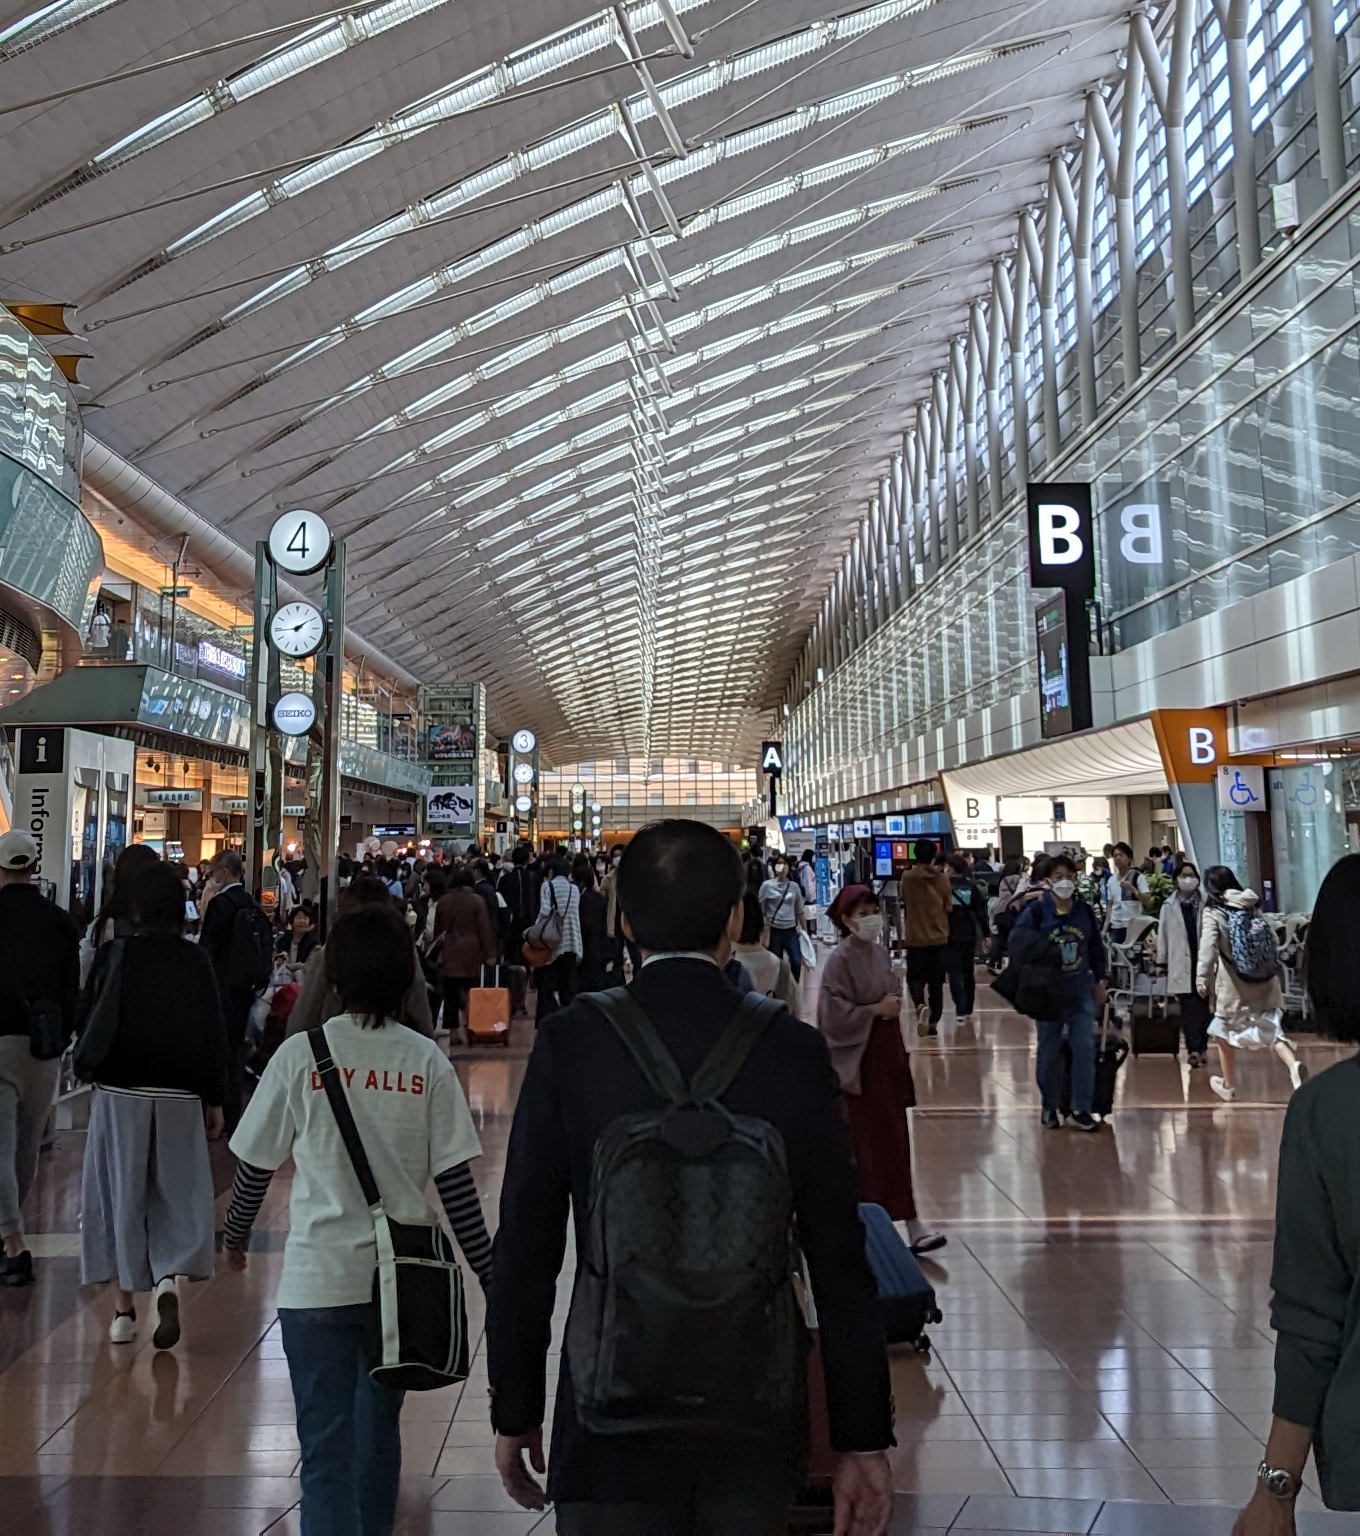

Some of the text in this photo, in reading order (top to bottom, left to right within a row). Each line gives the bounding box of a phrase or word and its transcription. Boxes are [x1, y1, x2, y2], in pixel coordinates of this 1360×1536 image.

[286, 521, 309, 559] 4
[1038, 504, 1084, 565] B
[277, 709, 313, 718] SEIKO
[519, 734, 528, 749] 3
[1189, 728, 1216, 763] B
[763, 747, 782, 768] A
[966, 798, 980, 818] B
[783, 819, 795, 831] A
[311, 1067, 424, 1095] DY ALLS
